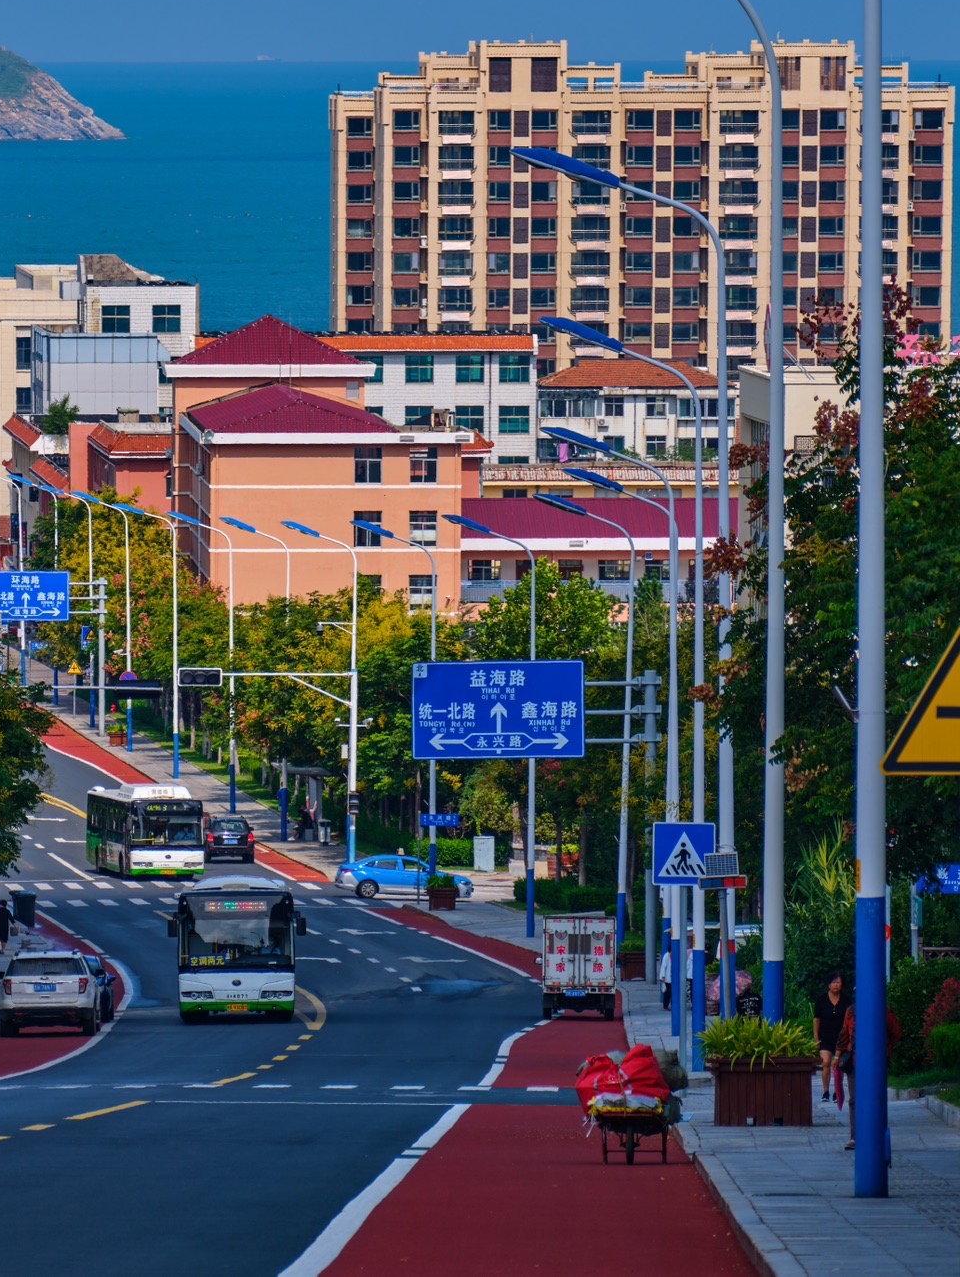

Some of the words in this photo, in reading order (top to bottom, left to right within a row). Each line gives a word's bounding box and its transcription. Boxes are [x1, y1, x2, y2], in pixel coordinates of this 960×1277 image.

[11, 575, 40, 584] 环海路
[37, 592, 65, 601] 鑫海路
[469, 669, 526, 687] 益海路
[418, 702, 476, 720] 统一北路
[521, 701, 578, 719] 鑫海路
[476, 735, 522, 748] 永兴路
[190, 955, 225, 967] 空调两元
